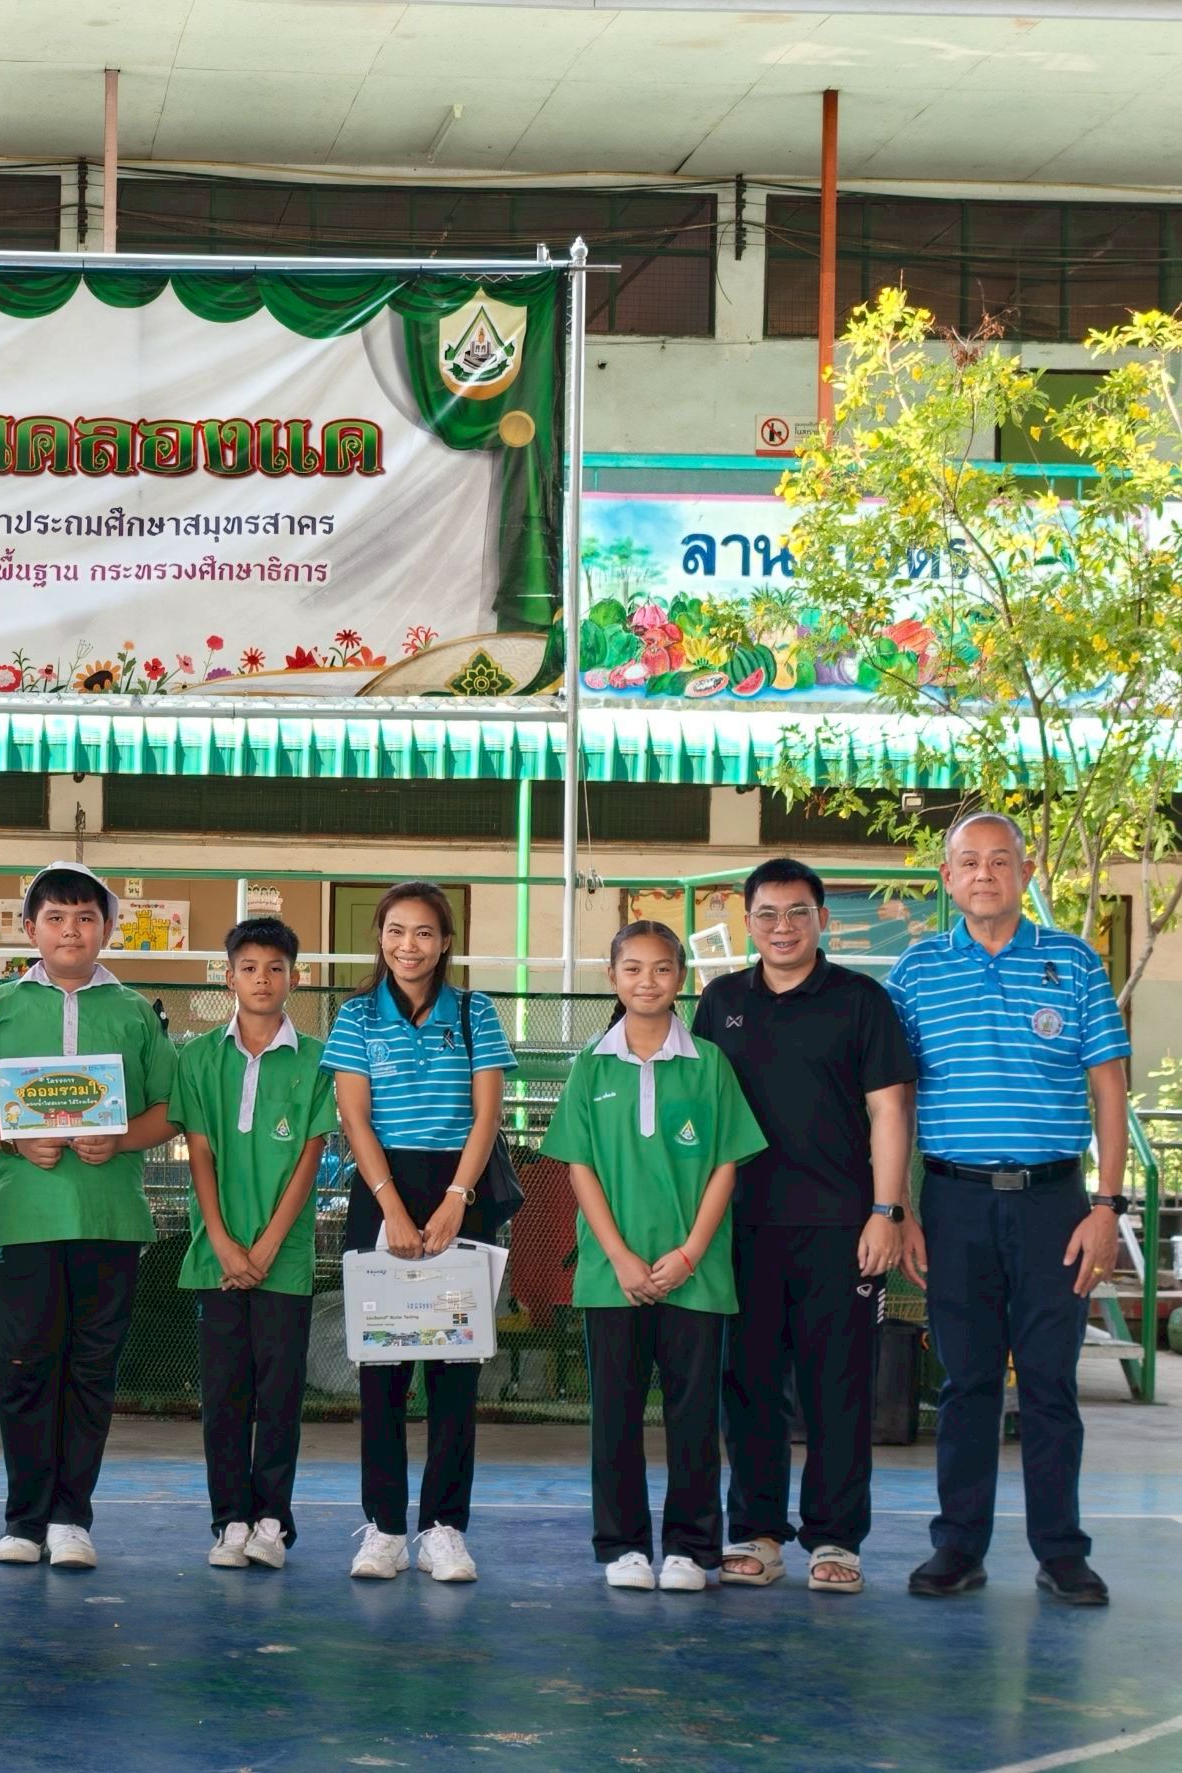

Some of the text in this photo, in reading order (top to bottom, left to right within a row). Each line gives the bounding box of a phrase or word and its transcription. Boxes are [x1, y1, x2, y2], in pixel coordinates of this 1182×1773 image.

[90, 554, 328, 583] กระทรวงศึกษาธิการ
